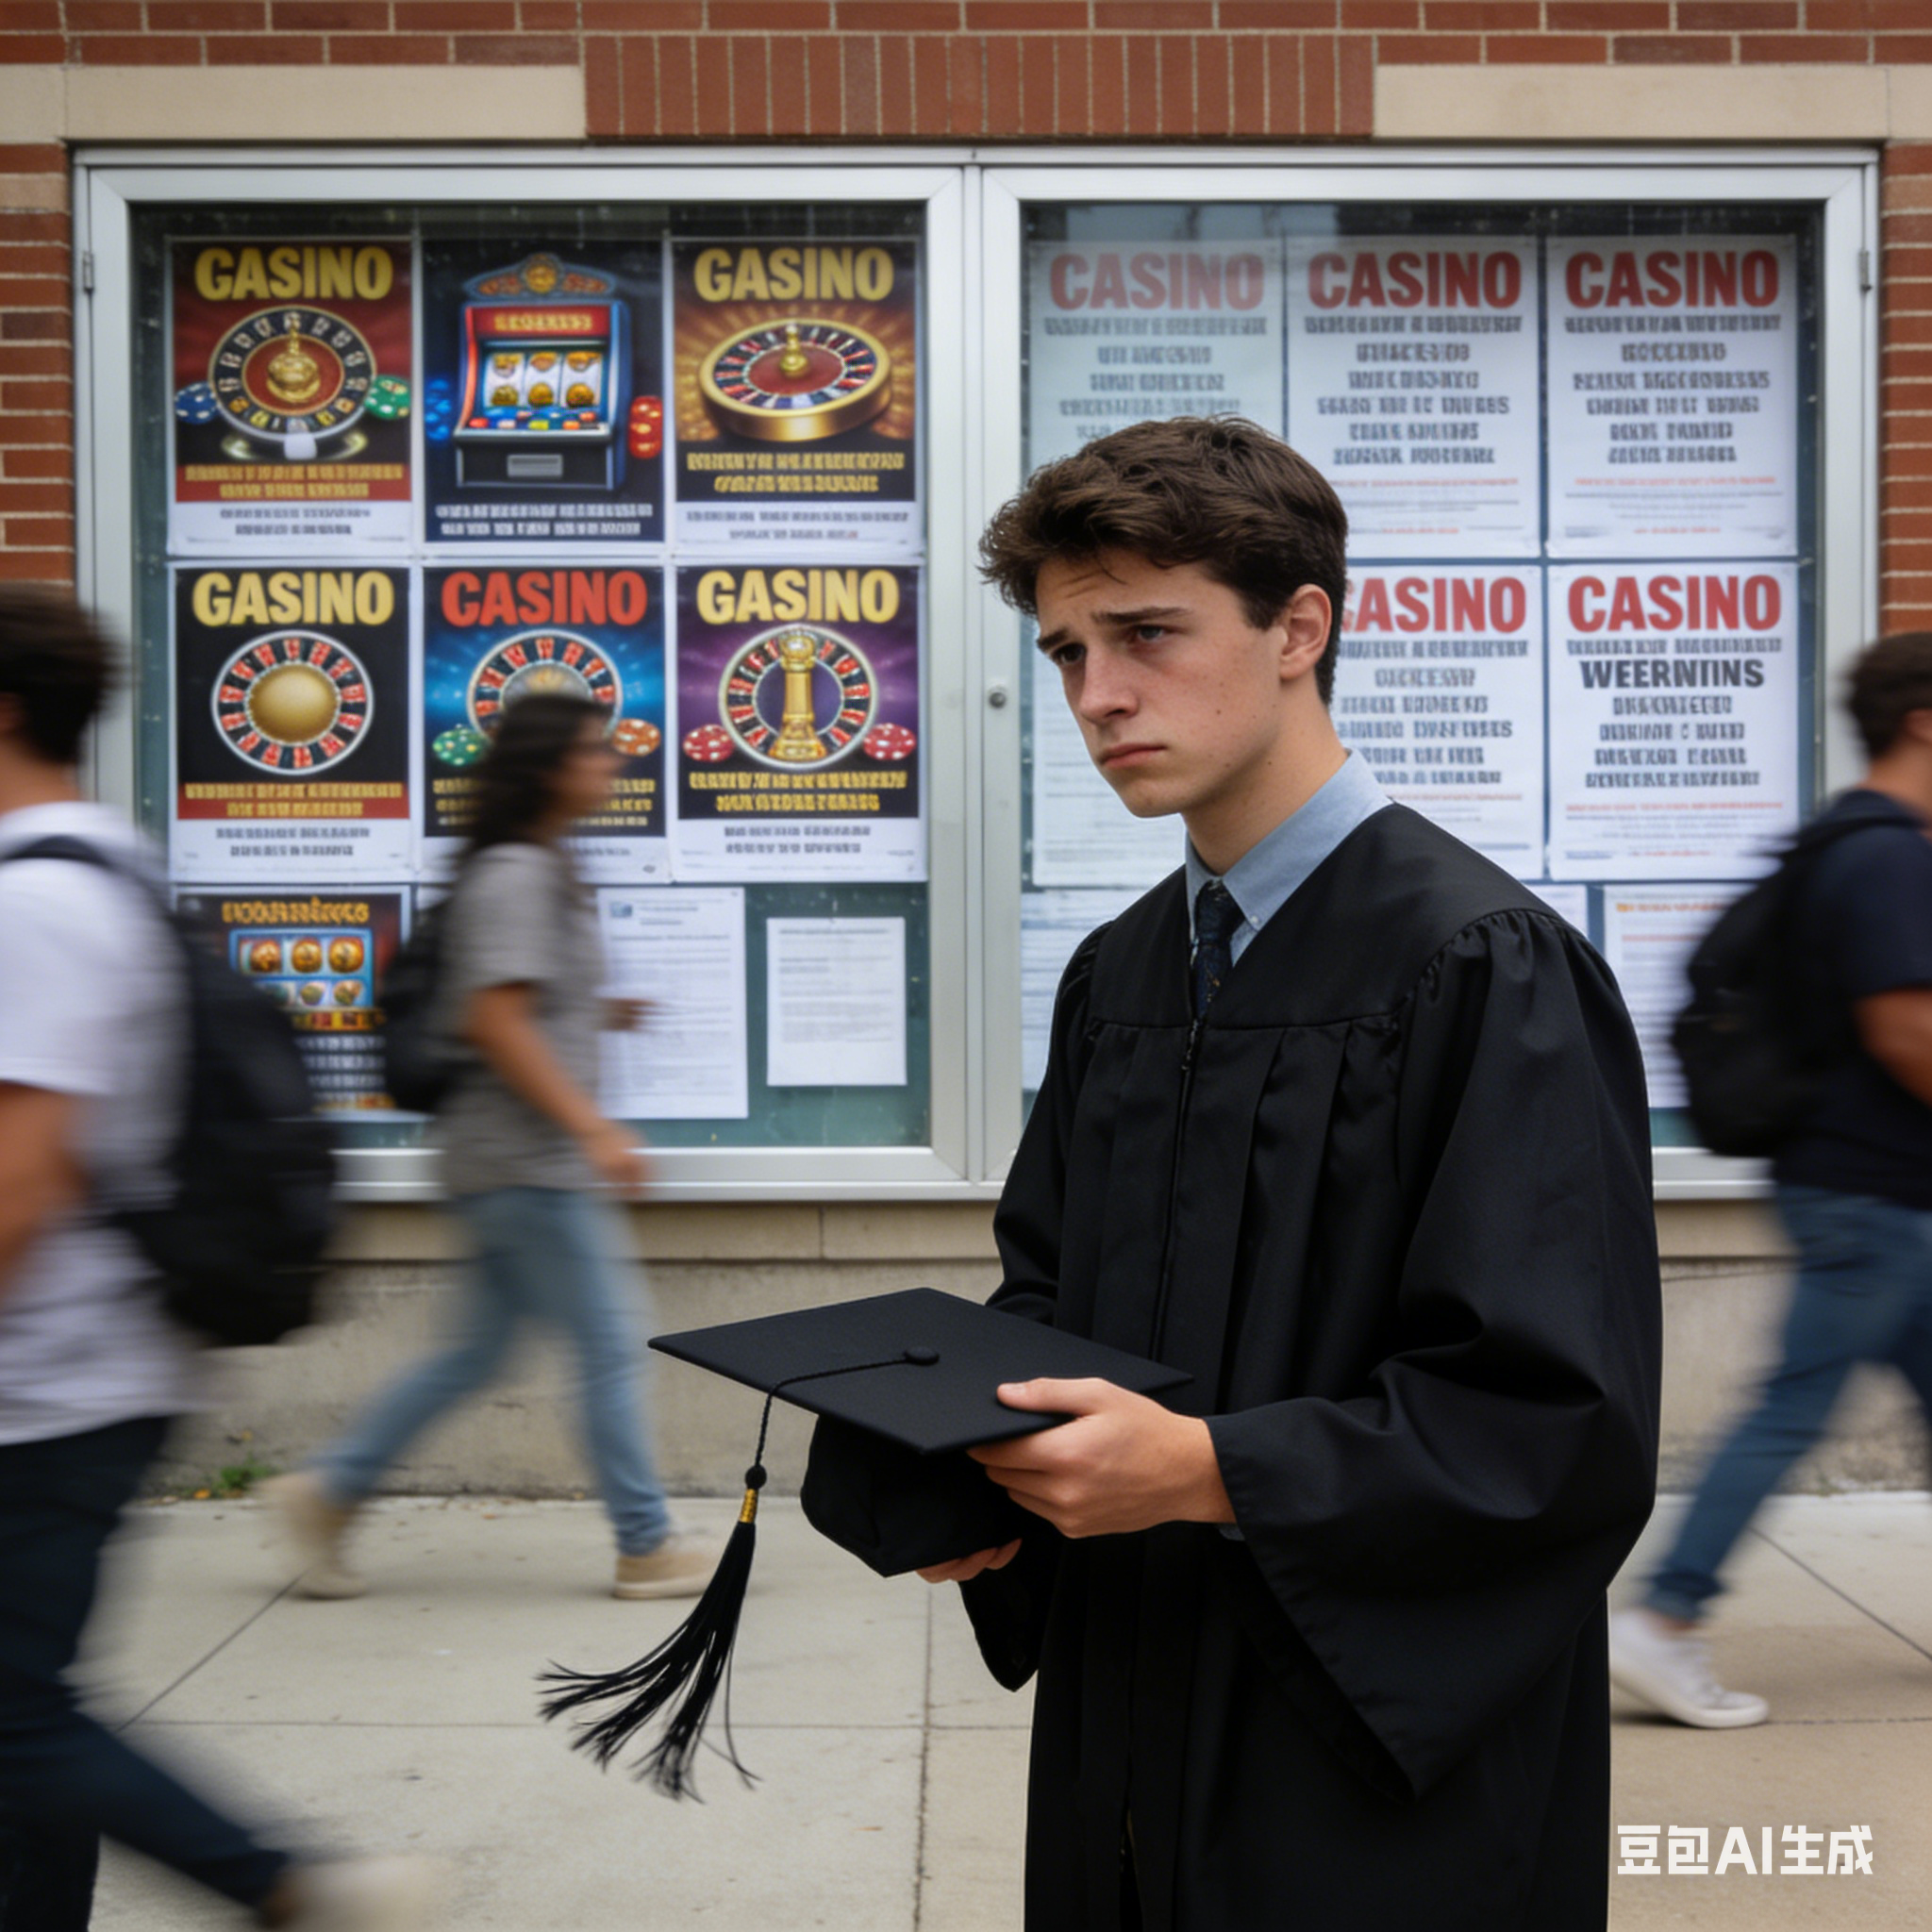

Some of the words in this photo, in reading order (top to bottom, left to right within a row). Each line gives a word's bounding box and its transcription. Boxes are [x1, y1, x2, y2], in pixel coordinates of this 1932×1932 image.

[1050, 252, 1265, 309] CASINO
[1308, 252, 1521, 309] CASINO
[1565, 250, 1779, 308] CASINO
[441, 570, 648, 626] CASINO
[1342, 576, 1526, 633] ASINO
[1568, 575, 1782, 632] CASINO
